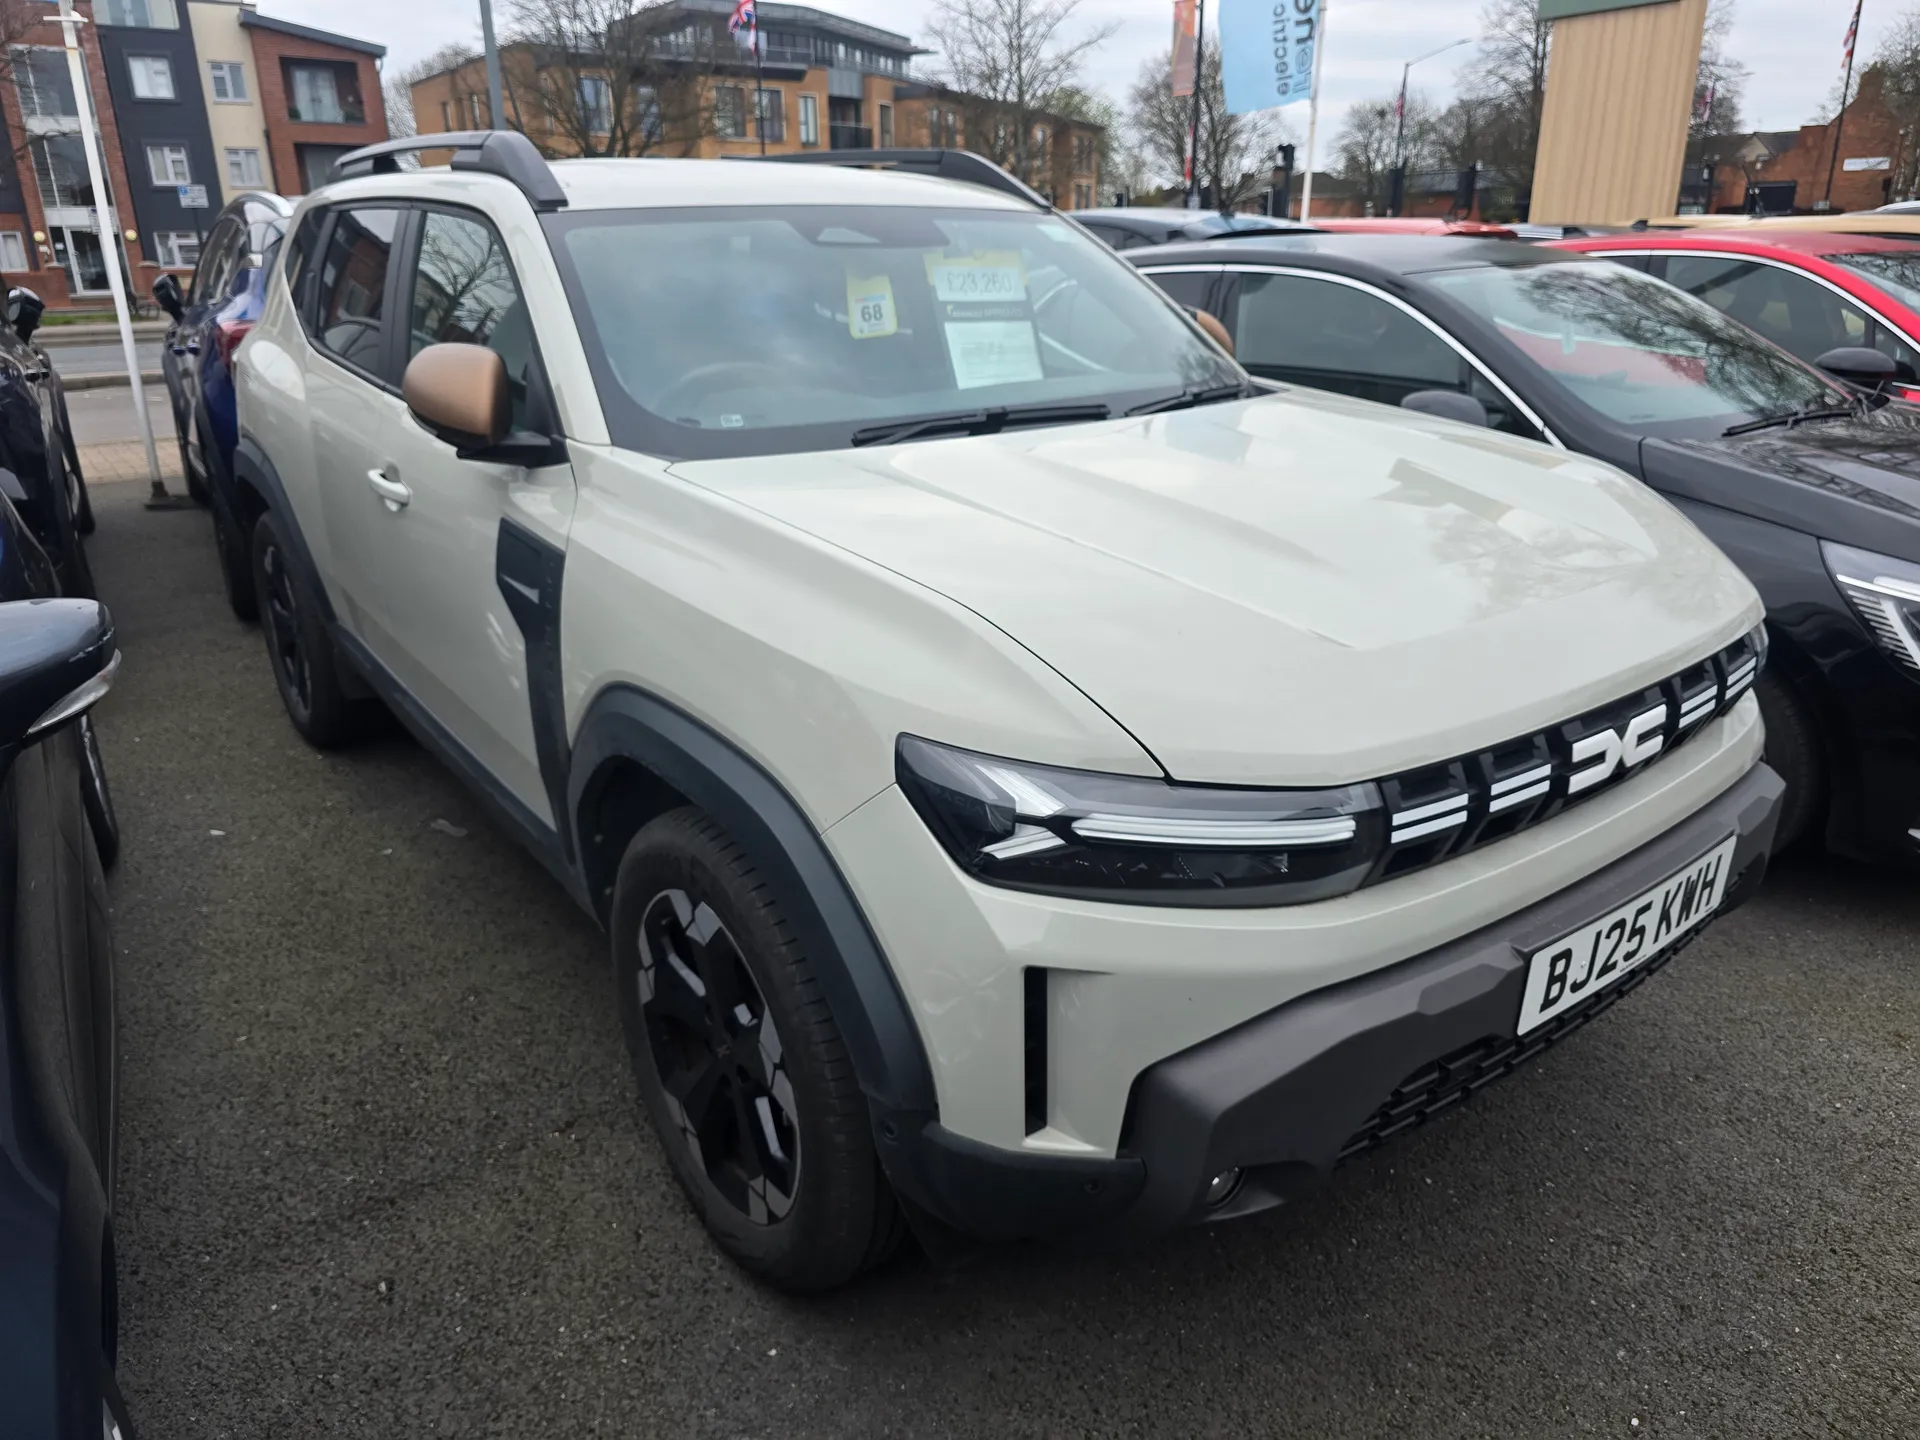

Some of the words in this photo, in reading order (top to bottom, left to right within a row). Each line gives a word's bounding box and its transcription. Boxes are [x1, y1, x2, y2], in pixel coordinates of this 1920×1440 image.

[861, 303, 884, 322] 68
[1539, 900, 1654, 1014] BJ25
[1653, 853, 1723, 944] KWH
